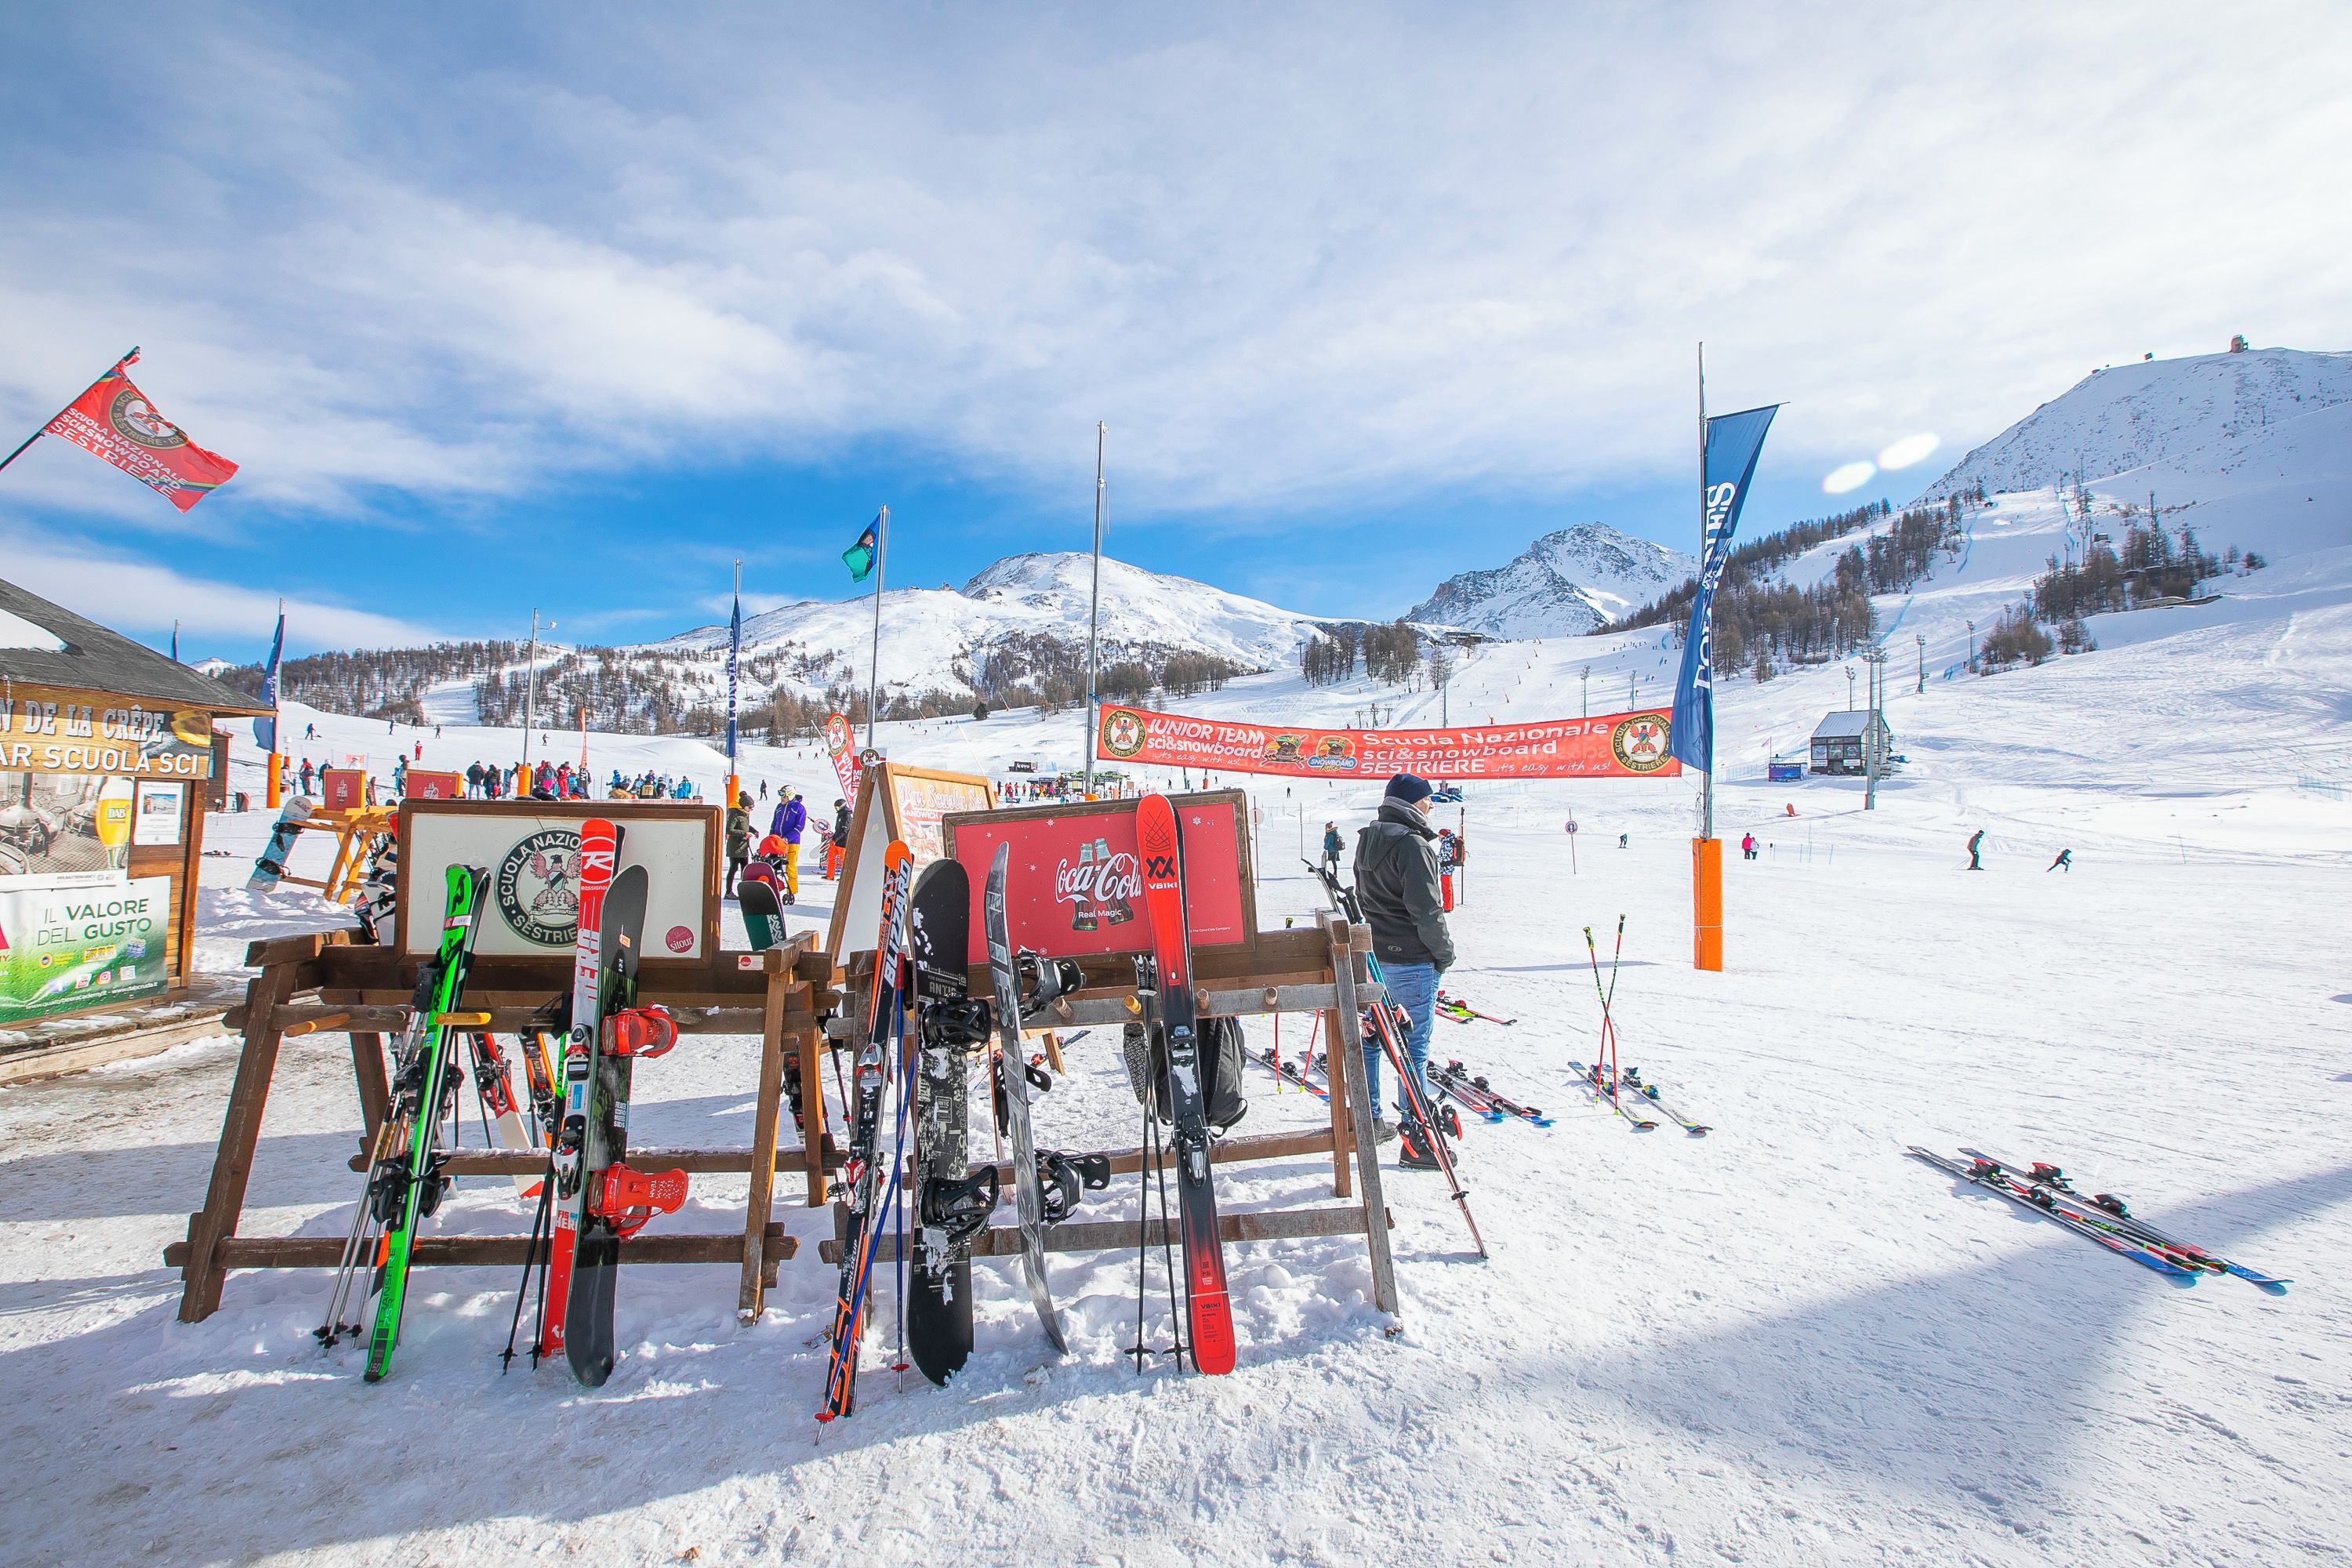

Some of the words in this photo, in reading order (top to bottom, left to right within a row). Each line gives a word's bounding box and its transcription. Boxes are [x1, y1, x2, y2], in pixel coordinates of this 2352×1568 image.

[49, 420, 177, 499] SESTRIERE
[60, 413, 183, 490] SCI&SNOWBOARD
[67, 407, 108, 435] SCUOLA
[111, 432, 189, 486] NAZIONALE
[23, 700, 57, 735] DE
[65, 704, 93, 738] LA
[102, 704, 165, 743] CRÊPE
[1146, 717, 1215, 739] JUNIOR
[1216, 726, 1265, 745] TEAM
[1362, 732, 1453, 746] Scuola
[1461, 720, 1610, 745] Nazionale
[1147, 735, 1265, 759] sci&snowboard
[1363, 739, 1558, 760] sci&snowboard
[1615, 722, 1632, 753] SCUOLA
[42, 746, 151, 772] SCUOLA
[157, 753, 198, 775] SCI
[1176, 753, 1198, 764] easy
[1310, 757, 1355, 767] SNOWBOARD
[1359, 758, 1486, 774] SESTRIERE
[1521, 762, 1549, 775] easy
[1555, 760, 1586, 771] with
[1592, 760, 1611, 771] us!
[1621, 755, 1668, 771] SESTRIERE
[898, 781, 926, 807] Bar
[927, 784, 968, 811] Scuola
[107, 808, 126, 818] DAB
[902, 809, 939, 819] SANDWICH
[500, 844, 533, 906] SCUOLA
[532, 833, 583, 850] NAZIO
[1054, 852, 1142, 904] Coca-Cola
[1148, 881, 1179, 890] Völkl
[44, 907, 58, 924] IL
[66, 898, 150, 921] VALORE
[884, 857, 912, 989] BLIZZARD
[1078, 910, 1097, 919] Real
[1098, 909, 1123, 919] Magic
[38, 927, 78, 946] DEL
[84, 917, 152, 940] GUSTO
[513, 915, 578, 943] SESTRIE
[670, 937, 693, 951] sitour
[845, 1239, 858, 1303] WORLDCUP
[379, 1247, 397, 1326] TRANSFIRE
[368, 1362, 382, 1373] 150
